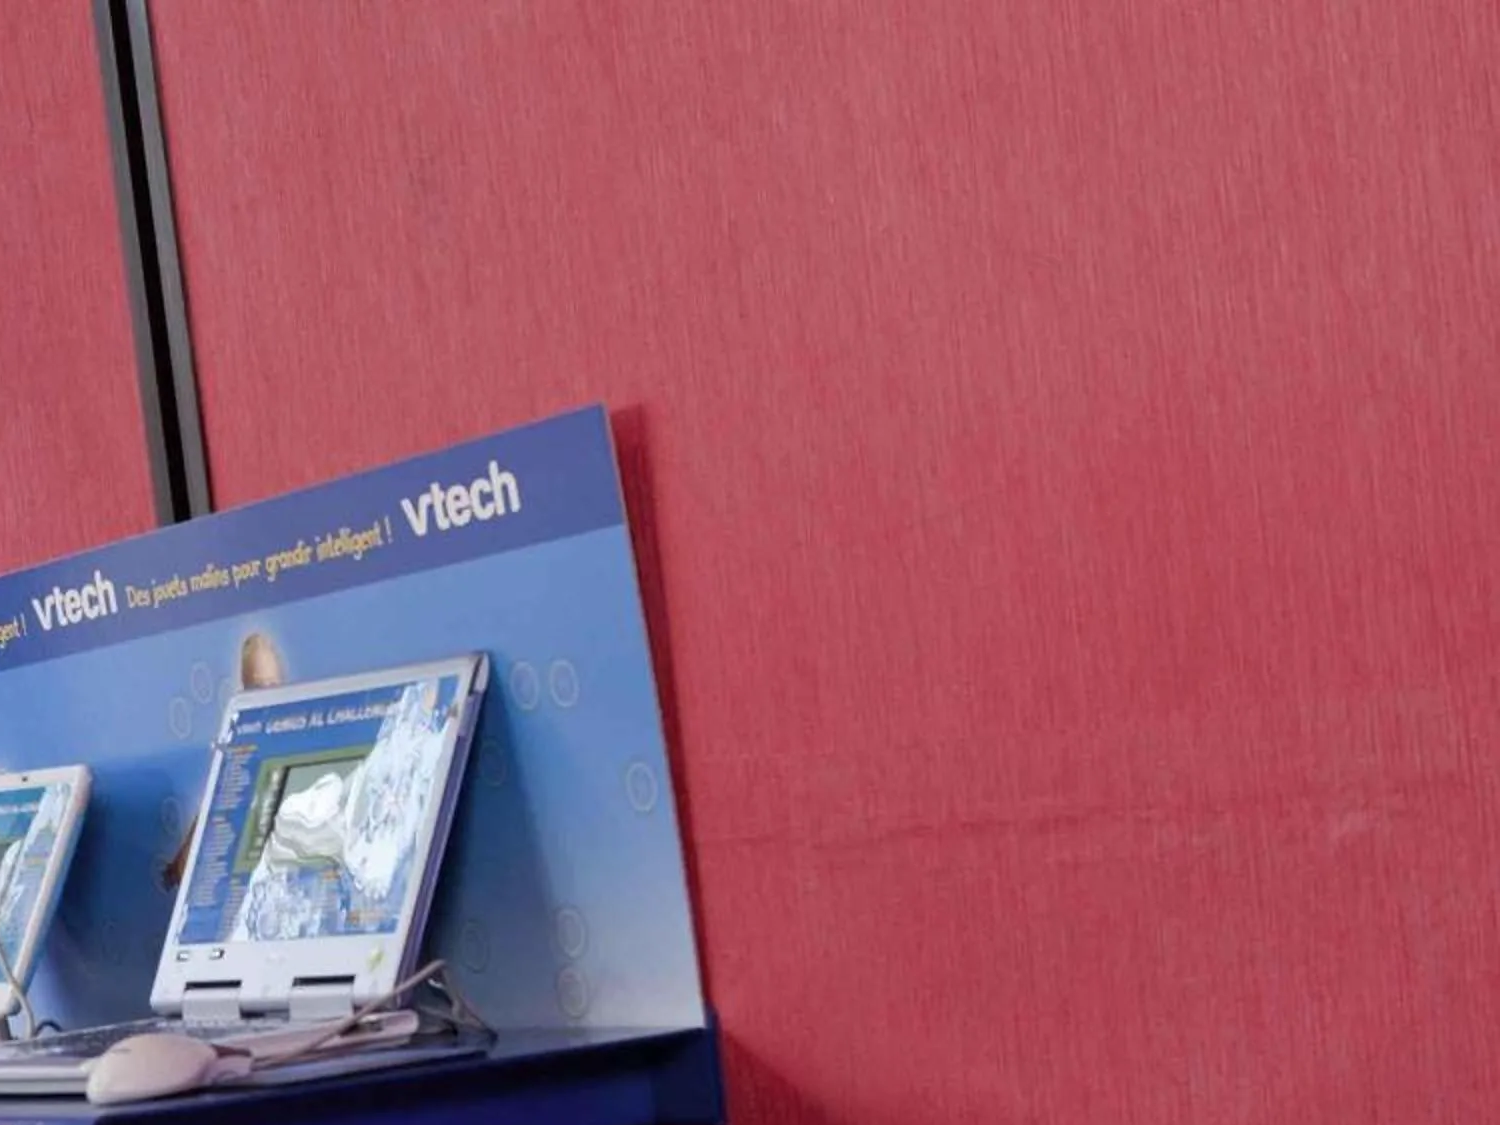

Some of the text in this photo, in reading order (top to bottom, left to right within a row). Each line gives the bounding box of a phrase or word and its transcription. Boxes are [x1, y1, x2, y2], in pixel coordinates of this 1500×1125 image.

[401, 459, 521, 538] vtech
[32, 569, 118, 632] vtech
[125, 585, 151, 609] Des
[151, 574, 189, 609] jouets
[233, 558, 262, 591] pour
[265, 540, 312, 583] grandir
[315, 522, 384, 562] intelligent
